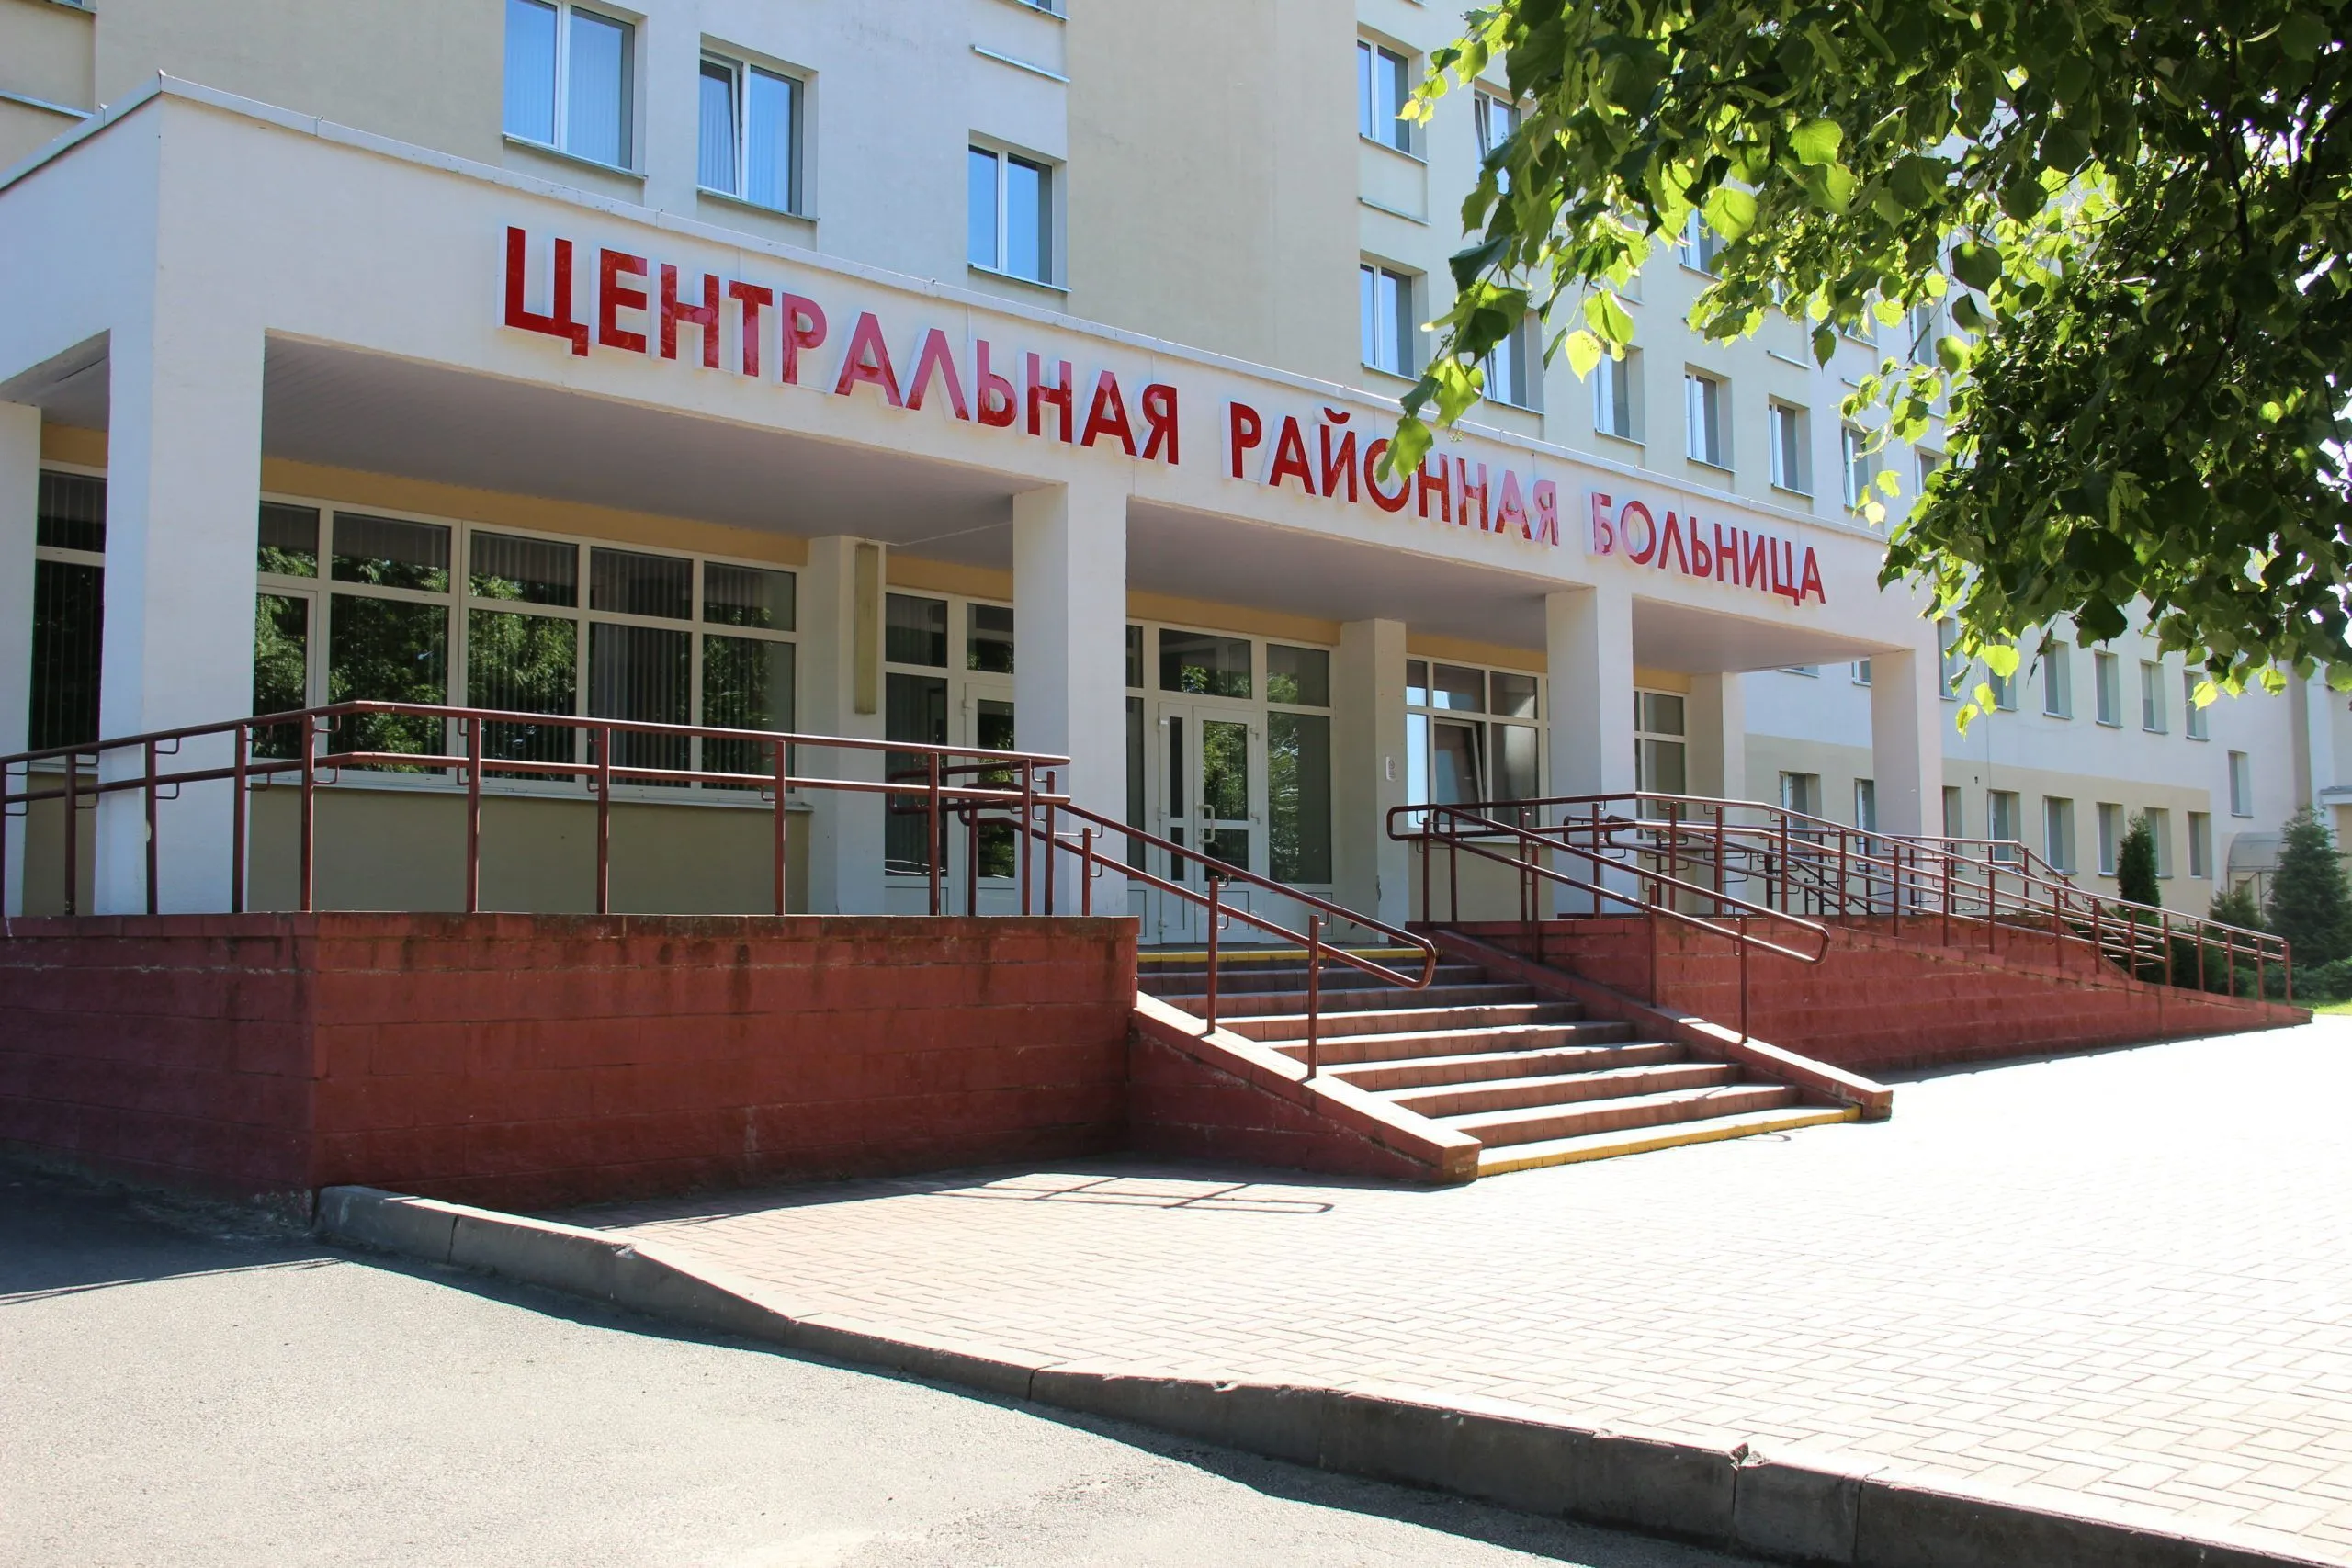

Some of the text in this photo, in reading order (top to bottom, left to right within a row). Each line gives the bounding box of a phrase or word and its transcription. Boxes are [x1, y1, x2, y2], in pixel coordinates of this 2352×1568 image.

[503, 225, 1826, 607] ЦЕНТРАЛЬНАЯ РАЙОННАЯ БОЛЬНИЦА
